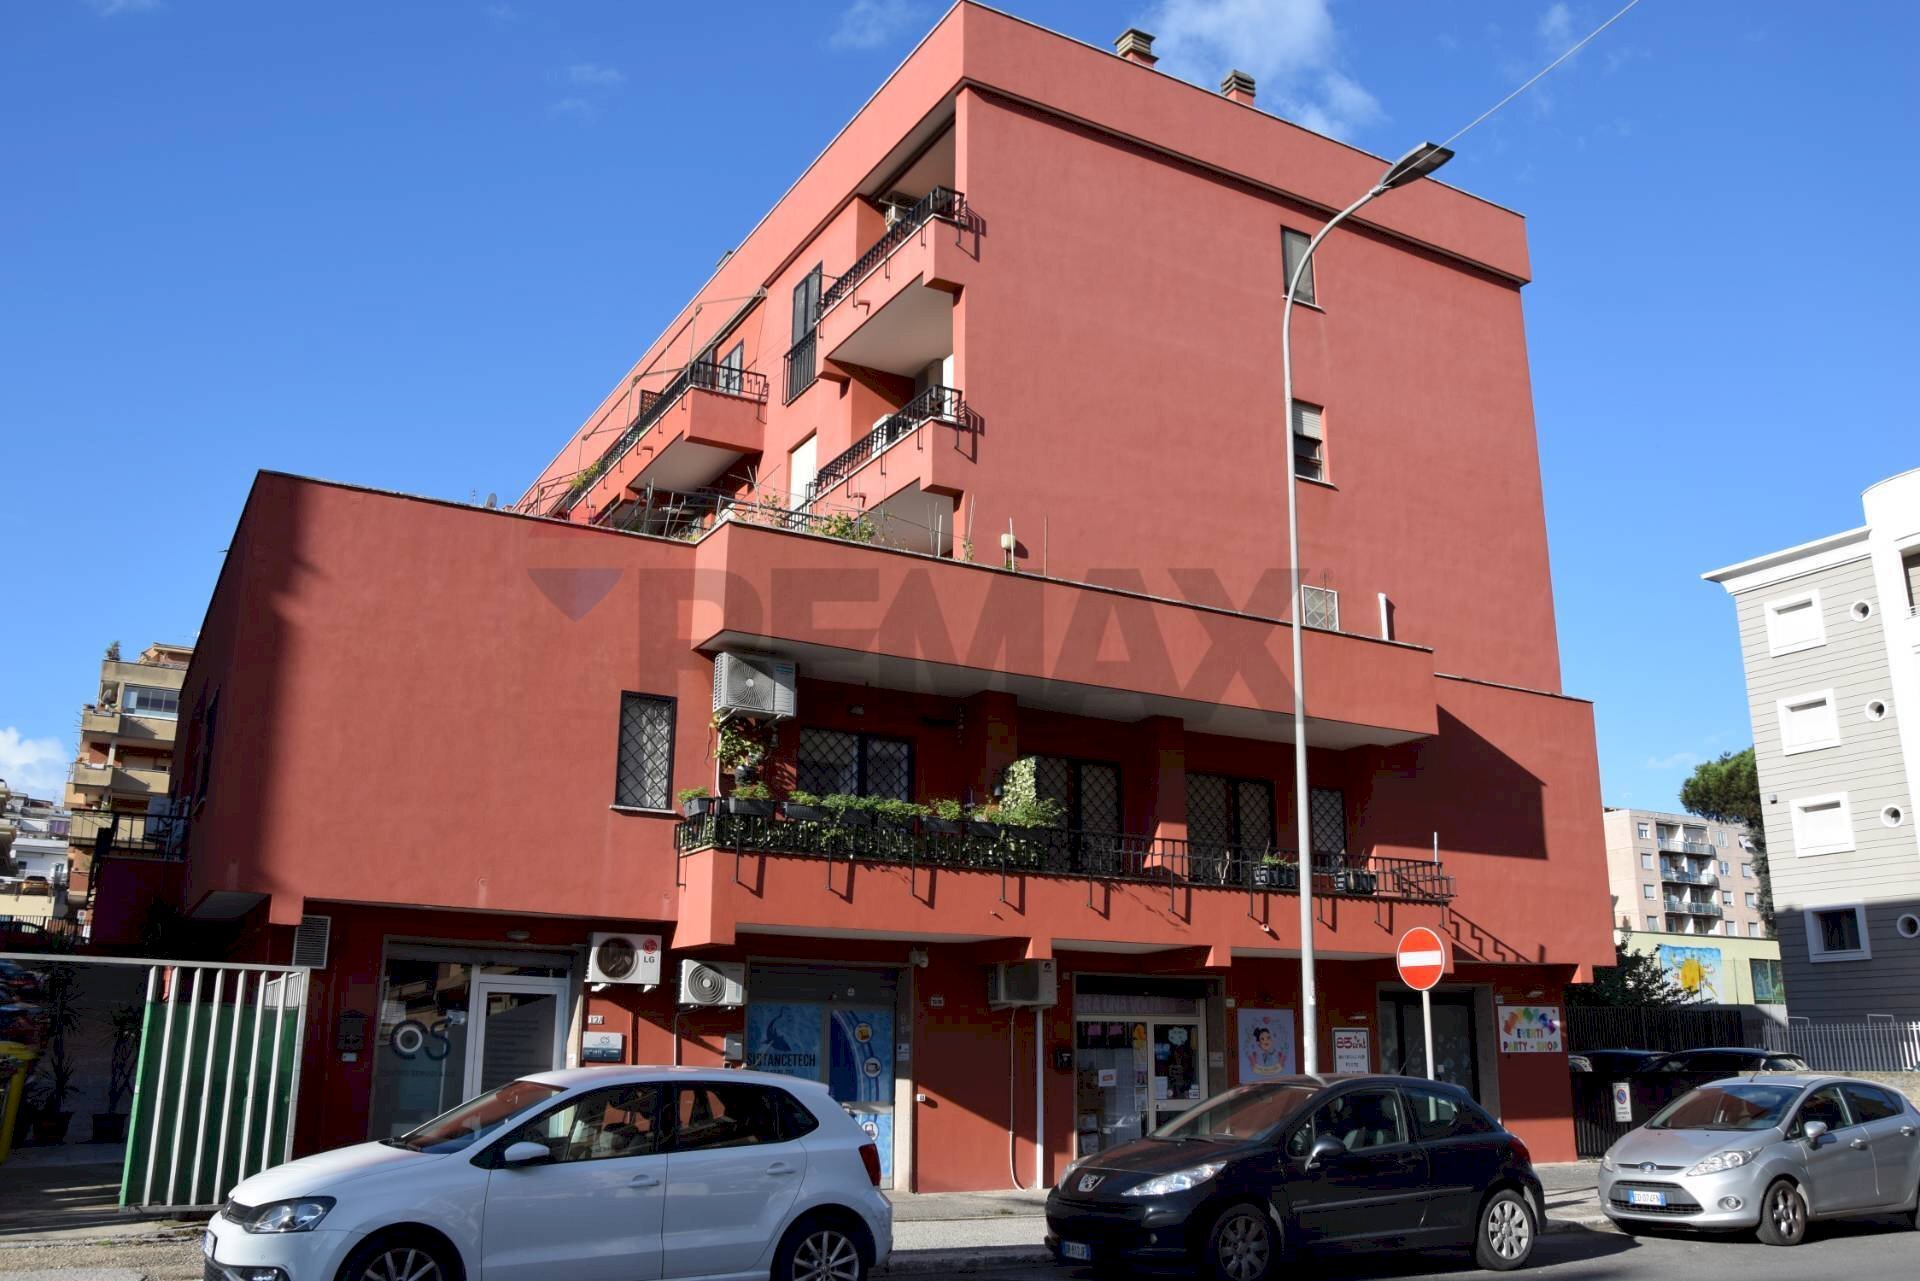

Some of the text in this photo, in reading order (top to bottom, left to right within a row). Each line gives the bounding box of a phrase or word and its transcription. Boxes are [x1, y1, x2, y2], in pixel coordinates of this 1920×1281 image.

[1517, 1028, 1543, 1039] EVENTI
[1503, 1041, 1527, 1051] PARTY
[1536, 1041, 1559, 1051] SHOP
